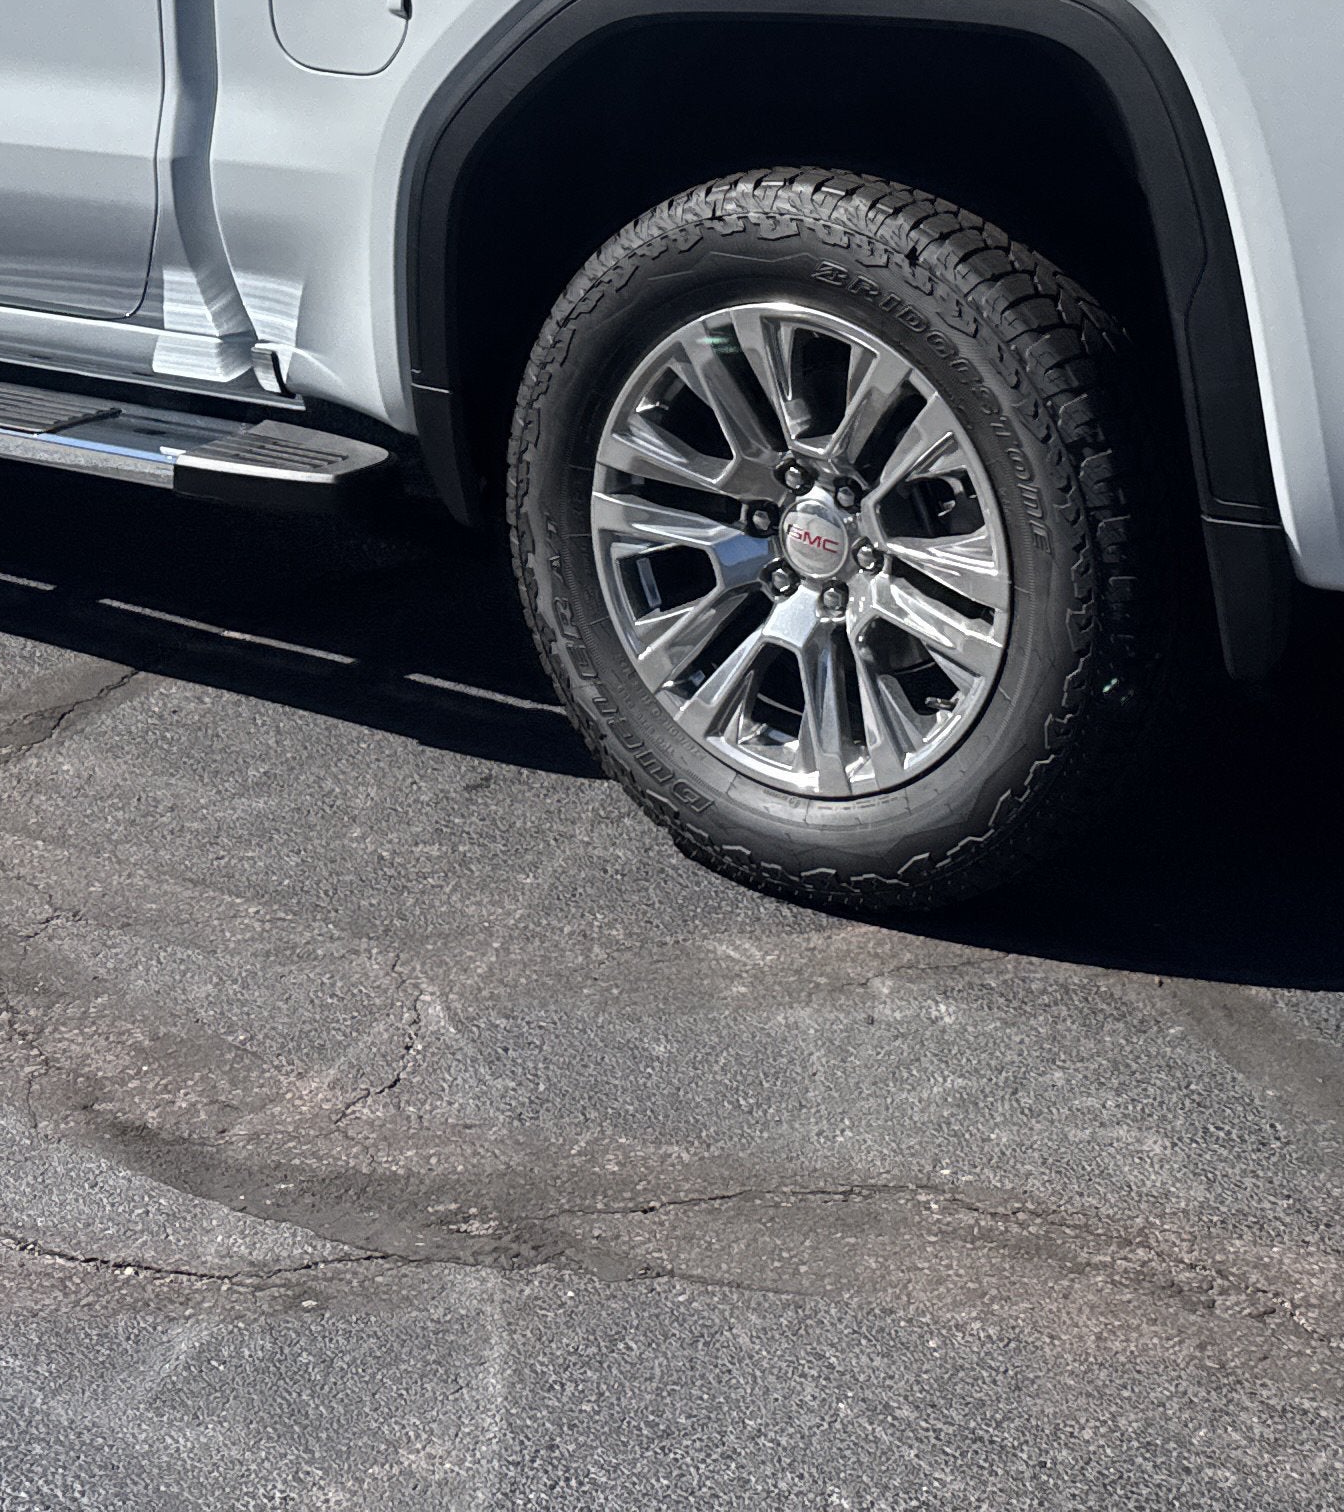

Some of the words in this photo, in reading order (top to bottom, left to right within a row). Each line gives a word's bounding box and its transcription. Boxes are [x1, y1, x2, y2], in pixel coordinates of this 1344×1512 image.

[810, 259, 1054, 555] BRIDGESTONE
[787, 523, 840, 554] GMC
[554, 593, 715, 814] DUELER
